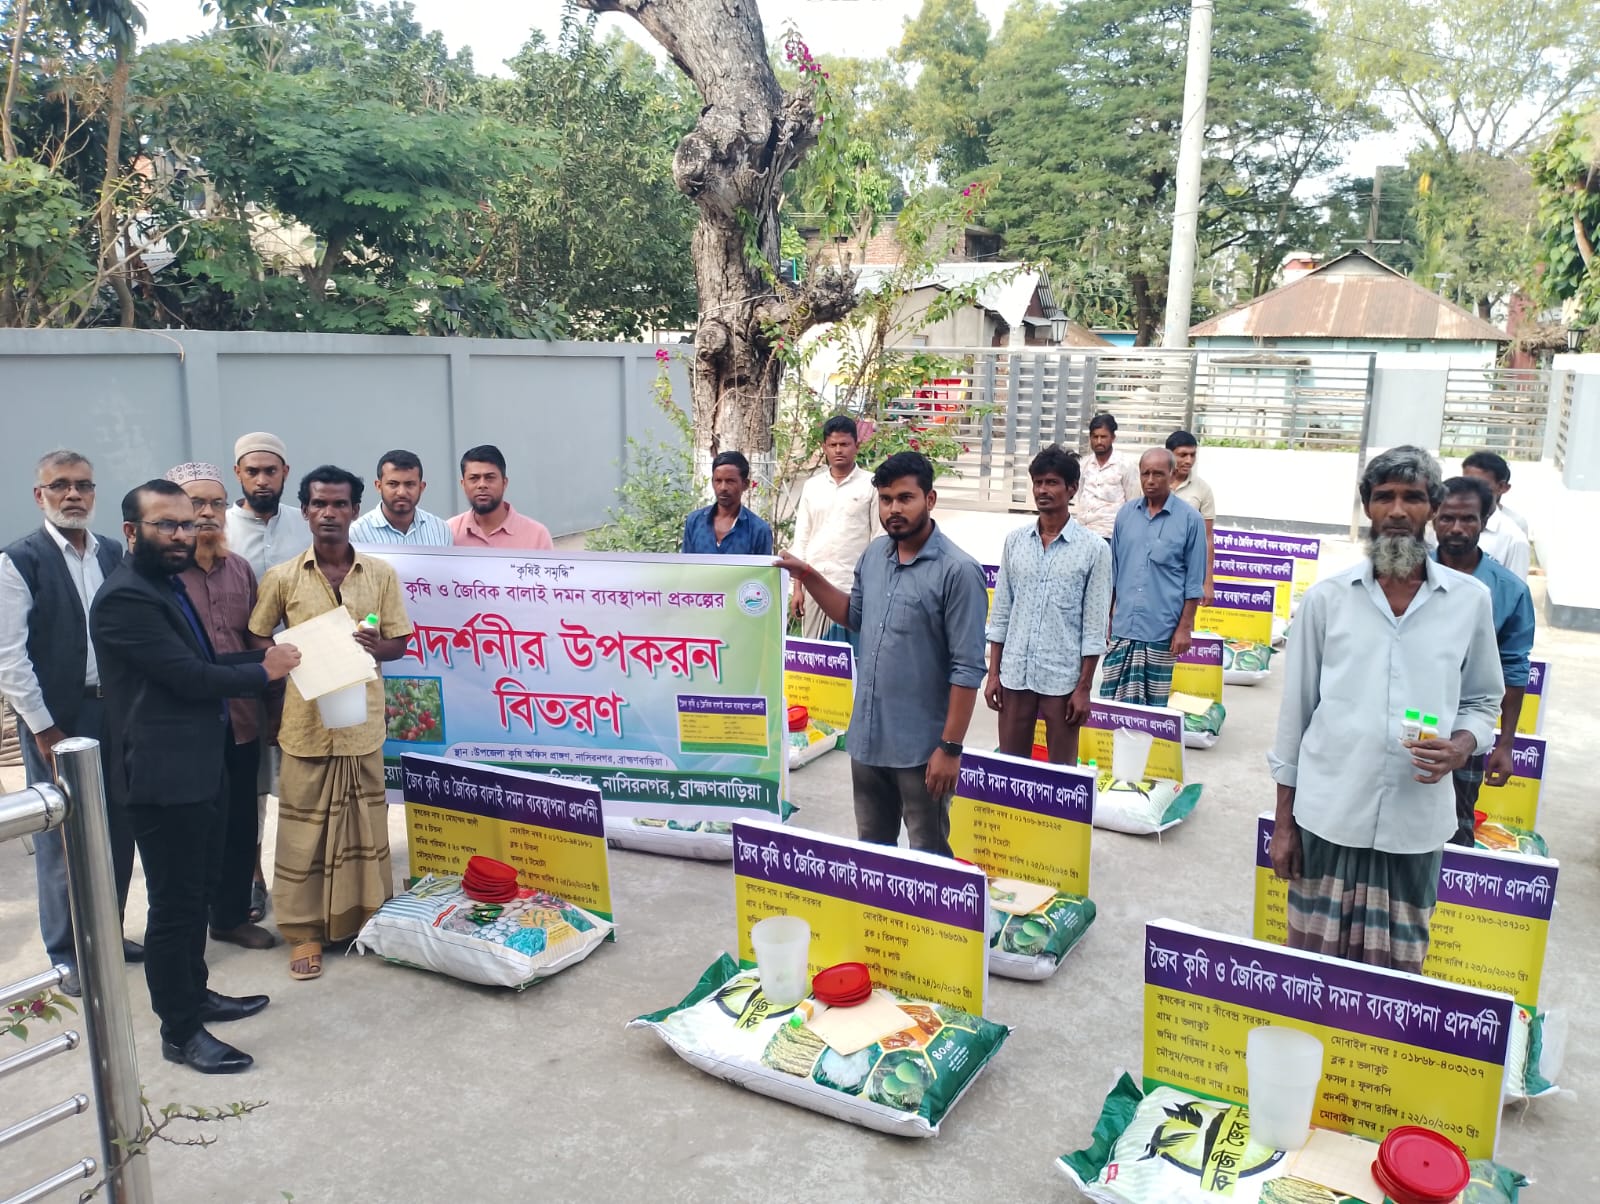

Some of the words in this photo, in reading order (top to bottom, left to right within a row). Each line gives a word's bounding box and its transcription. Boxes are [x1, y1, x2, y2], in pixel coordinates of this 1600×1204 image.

[510, 564, 541, 580] “কৃষিই
[403, 578, 432, 603] কৃষি
[436, 585, 449, 597] ও
[452, 579, 500, 600] জৈবিক
[504, 583, 549, 604] বালাই
[552, 588, 586, 604] দমন
[589, 589, 663, 609] ব্যবস্থাপনা
[667, 592, 726, 608] প্রকল্পের
[557, 618, 725, 680] উপকরন
[491, 677, 624, 735] বিতরণ
[508, 748, 523, 762] কৃষি
[405, 767, 423, 792] জৈব
[424, 770, 440, 801] কৃষি
[443, 780, 450, 795] ও
[450, 774, 478, 801] জৈবিক
[479, 782, 505, 808] বালাই
[505, 790, 524, 811] দমন
[525, 793, 567, 820] ব্যবস্থাপনা
[569, 798, 599, 824] প্রদর্শনী
[601, 772, 675, 799] নাসিরনগর,
[960, 766, 985, 791] বালাই
[988, 772, 1008, 794] দমন
[1010, 776, 1055, 804] ব্যবস্থাপনা
[1056, 784, 1089, 811] প্রদর্শনী
[737, 835, 759, 864] জৈব
[759, 841, 780, 876] কৃষি
[783, 852, 791, 870] ও
[792, 847, 826, 879] জৈবিক
[828, 858, 859, 890] বালাই
[860, 867, 884, 894] দমন
[886, 872, 938, 906] ব্যবস্থাপনা
[940, 883, 980, 916] প্রদর্শনী
[1441, 867, 1502, 899] ব্যবস্থাপনা
[1504, 875, 1551, 905] প্রদর্শনী
[1149, 939, 1179, 974] জৈব
[1182, 948, 1210, 988] কৃষি
[1215, 962, 1226, 983] ও
[1230, 956, 1278, 995] জৈবিক
[1281, 972, 1325, 1010] বালাই
[1328, 985, 1363, 1015] দমন
[1366, 992, 1441, 1032] ব্যবস্থাপনা
[1444, 1007, 1501, 1045] প্রদর্শনী
[1189, 1001, 1203, 1011] নাম
[1331, 1035, 1367, 1051] মোবাইল
[1370, 1043, 1389, 1057] নম্বর
[1325, 1072, 1347, 1086] ফসল
[1319, 1110, 1354, 1127] মোবাইল
